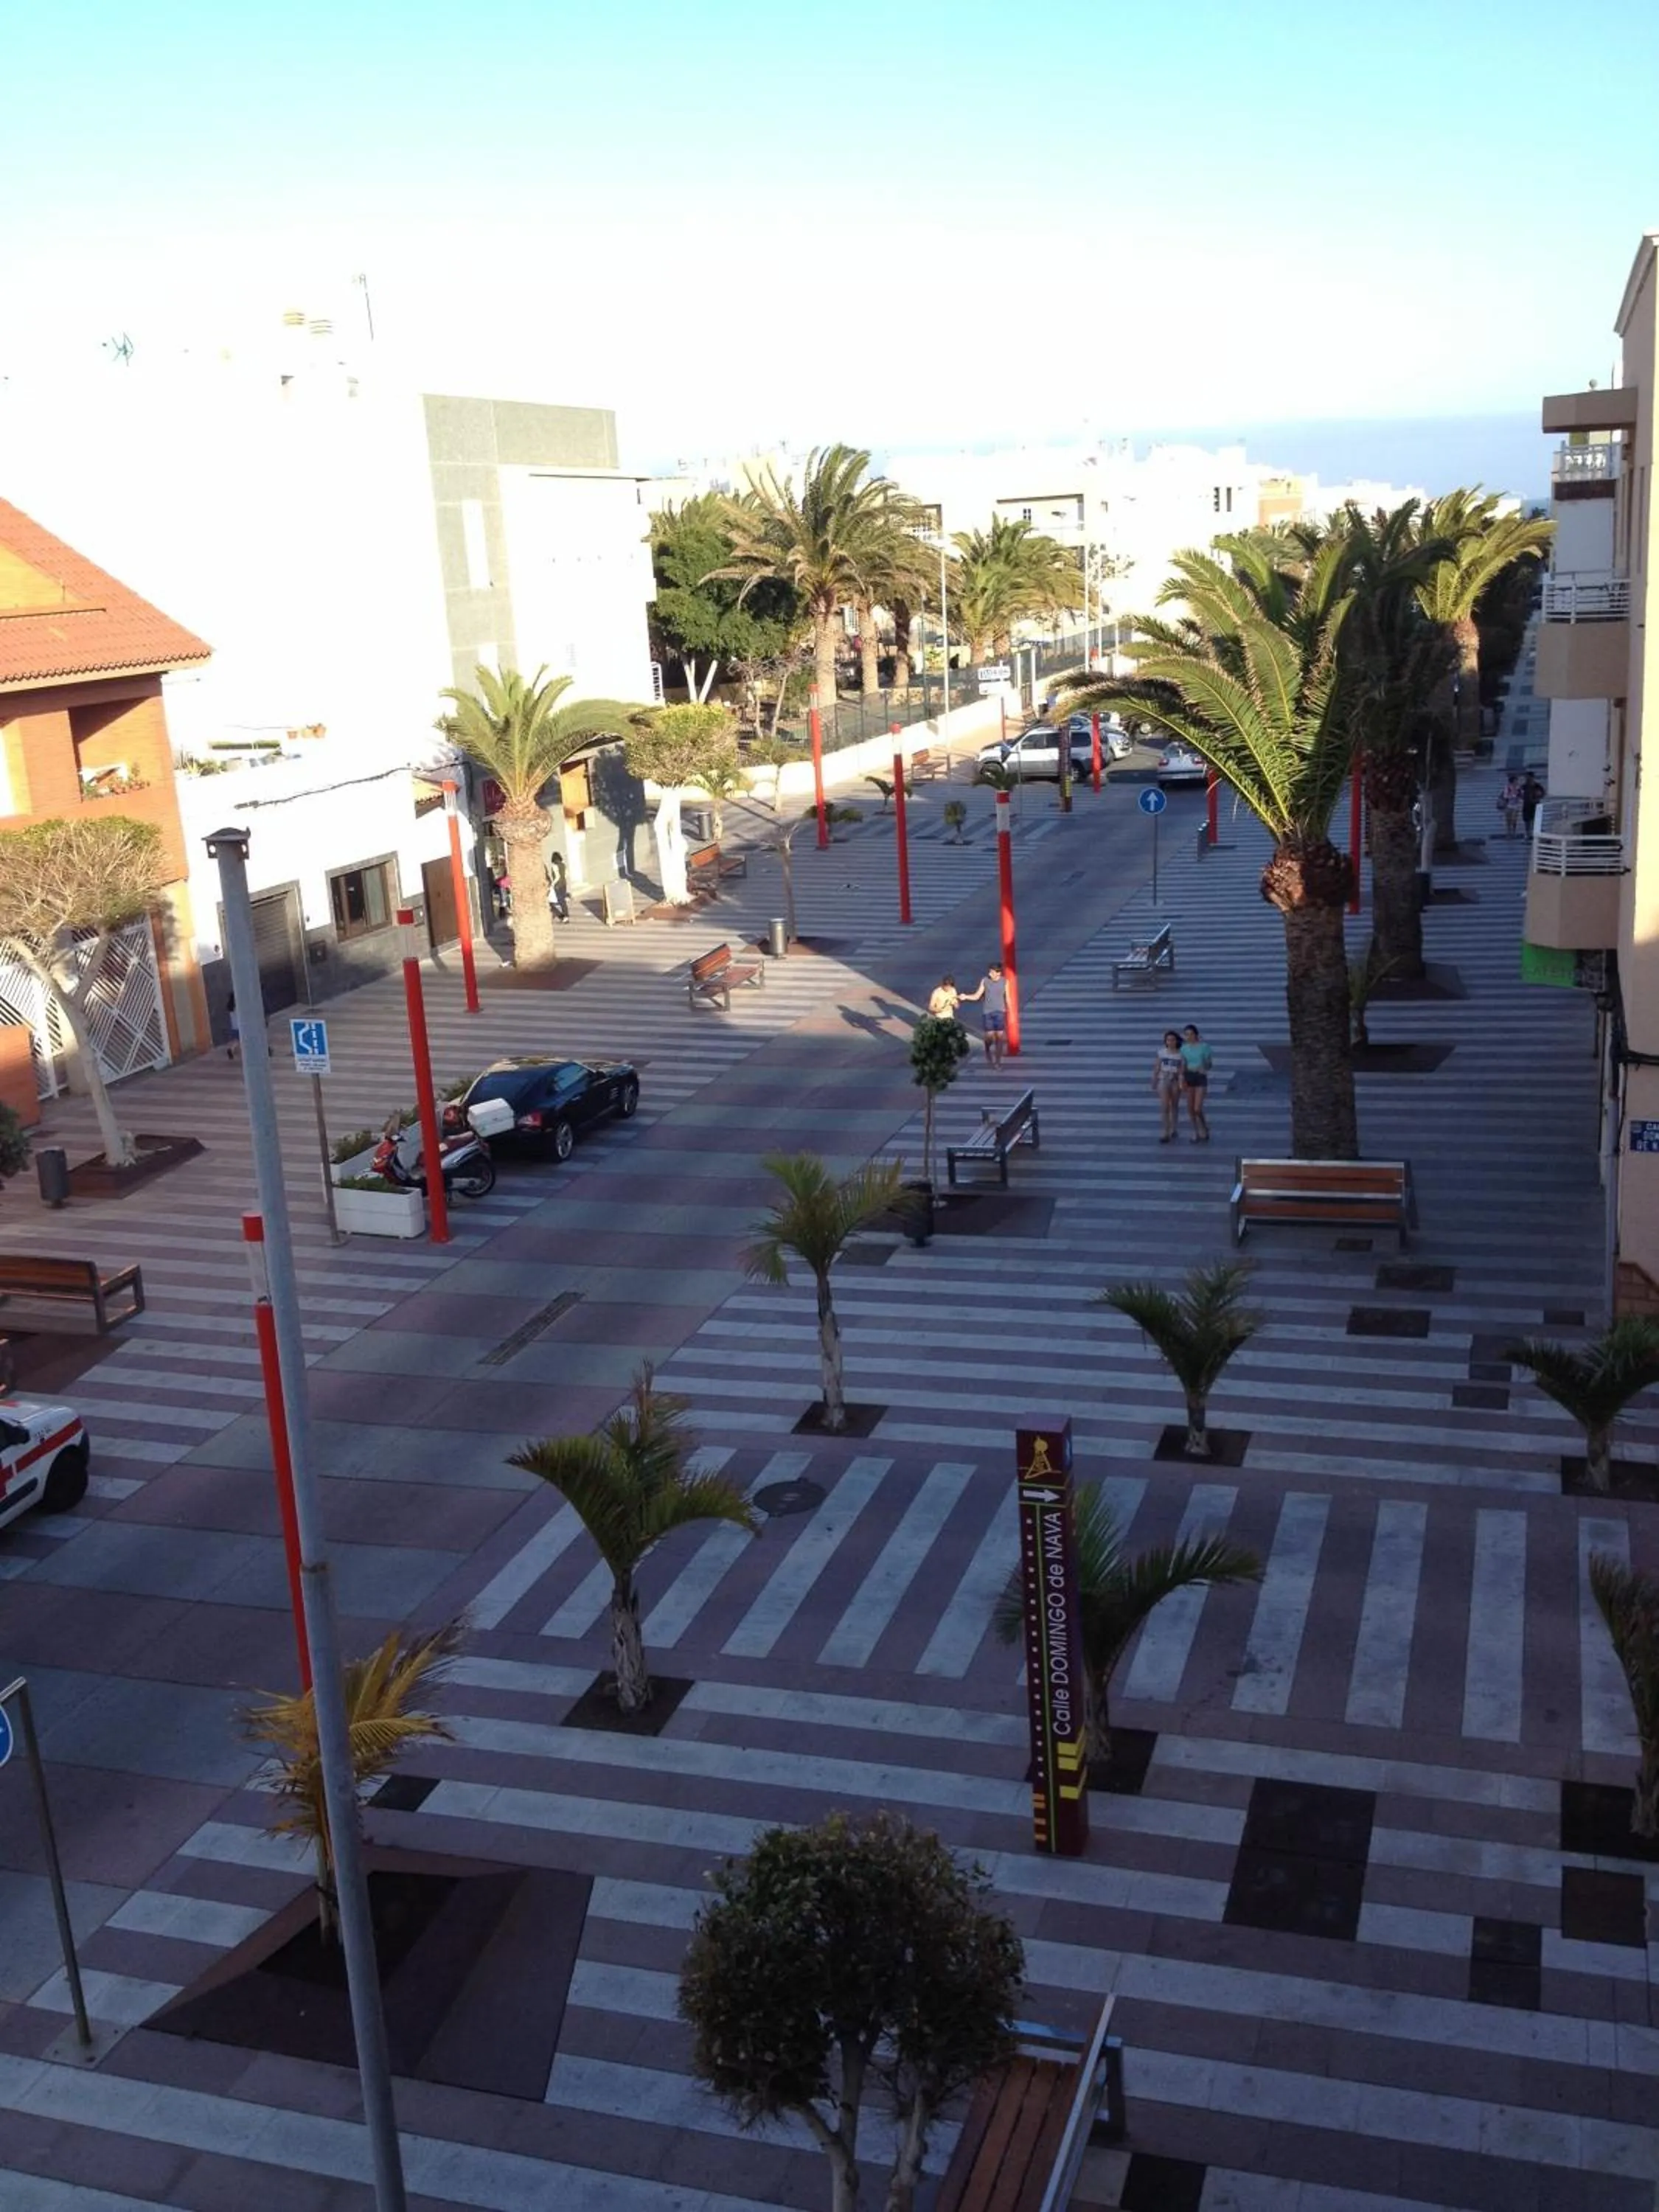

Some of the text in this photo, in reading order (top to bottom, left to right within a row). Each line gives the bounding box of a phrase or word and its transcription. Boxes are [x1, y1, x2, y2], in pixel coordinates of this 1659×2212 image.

[1043, 1512, 1071, 1735] Calle DOMINGO de NAVA
